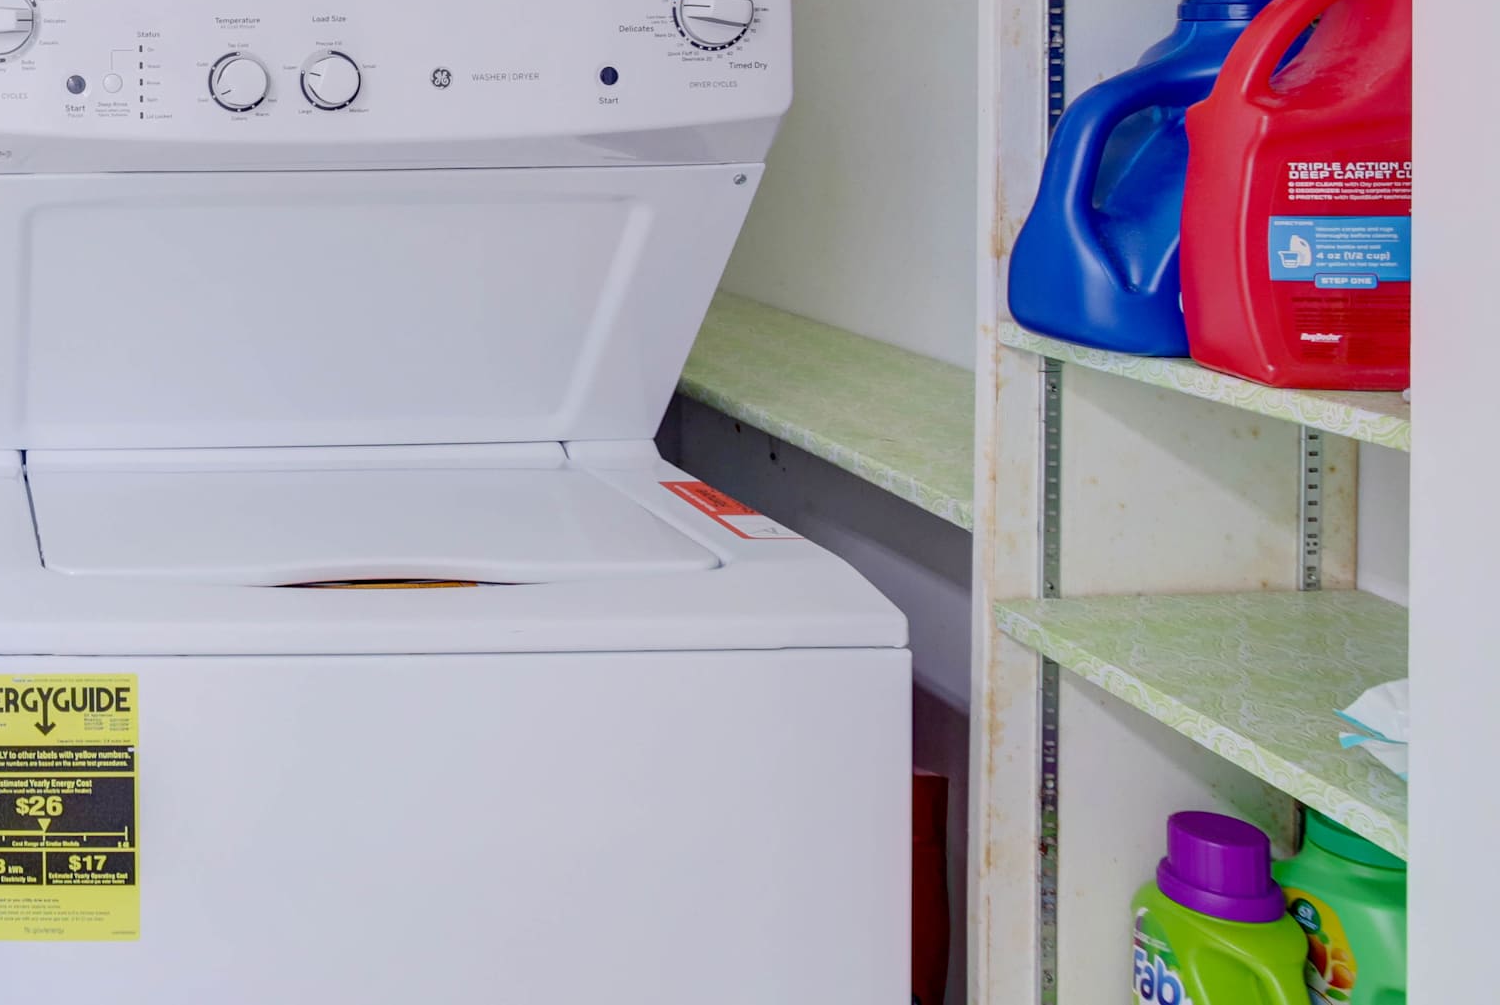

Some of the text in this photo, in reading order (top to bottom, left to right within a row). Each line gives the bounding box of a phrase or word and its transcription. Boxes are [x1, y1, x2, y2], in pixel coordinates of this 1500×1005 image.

[215, 17, 261, 25] Temperature
[312, 15, 346, 23] Load Size
[619, 25, 654, 33] Delicates
[754, 62, 768, 71] Dry
[471, 72, 540, 81] WASHER DRYER
[713, 81, 738, 89] CYCLES
[599, 97, 619, 105] Start
[65, 104, 86, 113] Start
[1288, 162, 1341, 171] TRIPLE
[1346, 162, 1399, 170] ACTION
[1288, 171, 1329, 179] DEEP
[1334, 171, 1392, 179] CARPET
[1316, 252, 1324, 260] 4
[1344, 252, 1363, 260] (1/2
[1366, 252, 1391, 261] cup)
[9, 751, 17, 759] to
[17, 751, 36, 759] other
[36, 750, 58, 759] labels
[58, 750, 74, 759] with
[74, 750, 97, 761] yellow
[98, 750, 131, 759] numbers.
[29, 779, 50, 789] Yearly
[51, 779, 75, 789] Energy
[76, 779, 92, 787] Cost
[15, 795, 64, 817] $26
[68, 854, 107, 872] $17
[8, 865, 24, 874] kWh
[0, 875, 27, 884] Electricity
[74, 873, 90, 881] Yearly
[91, 873, 115, 882] Operating
[1134, 947, 1182, 1005] Fab
